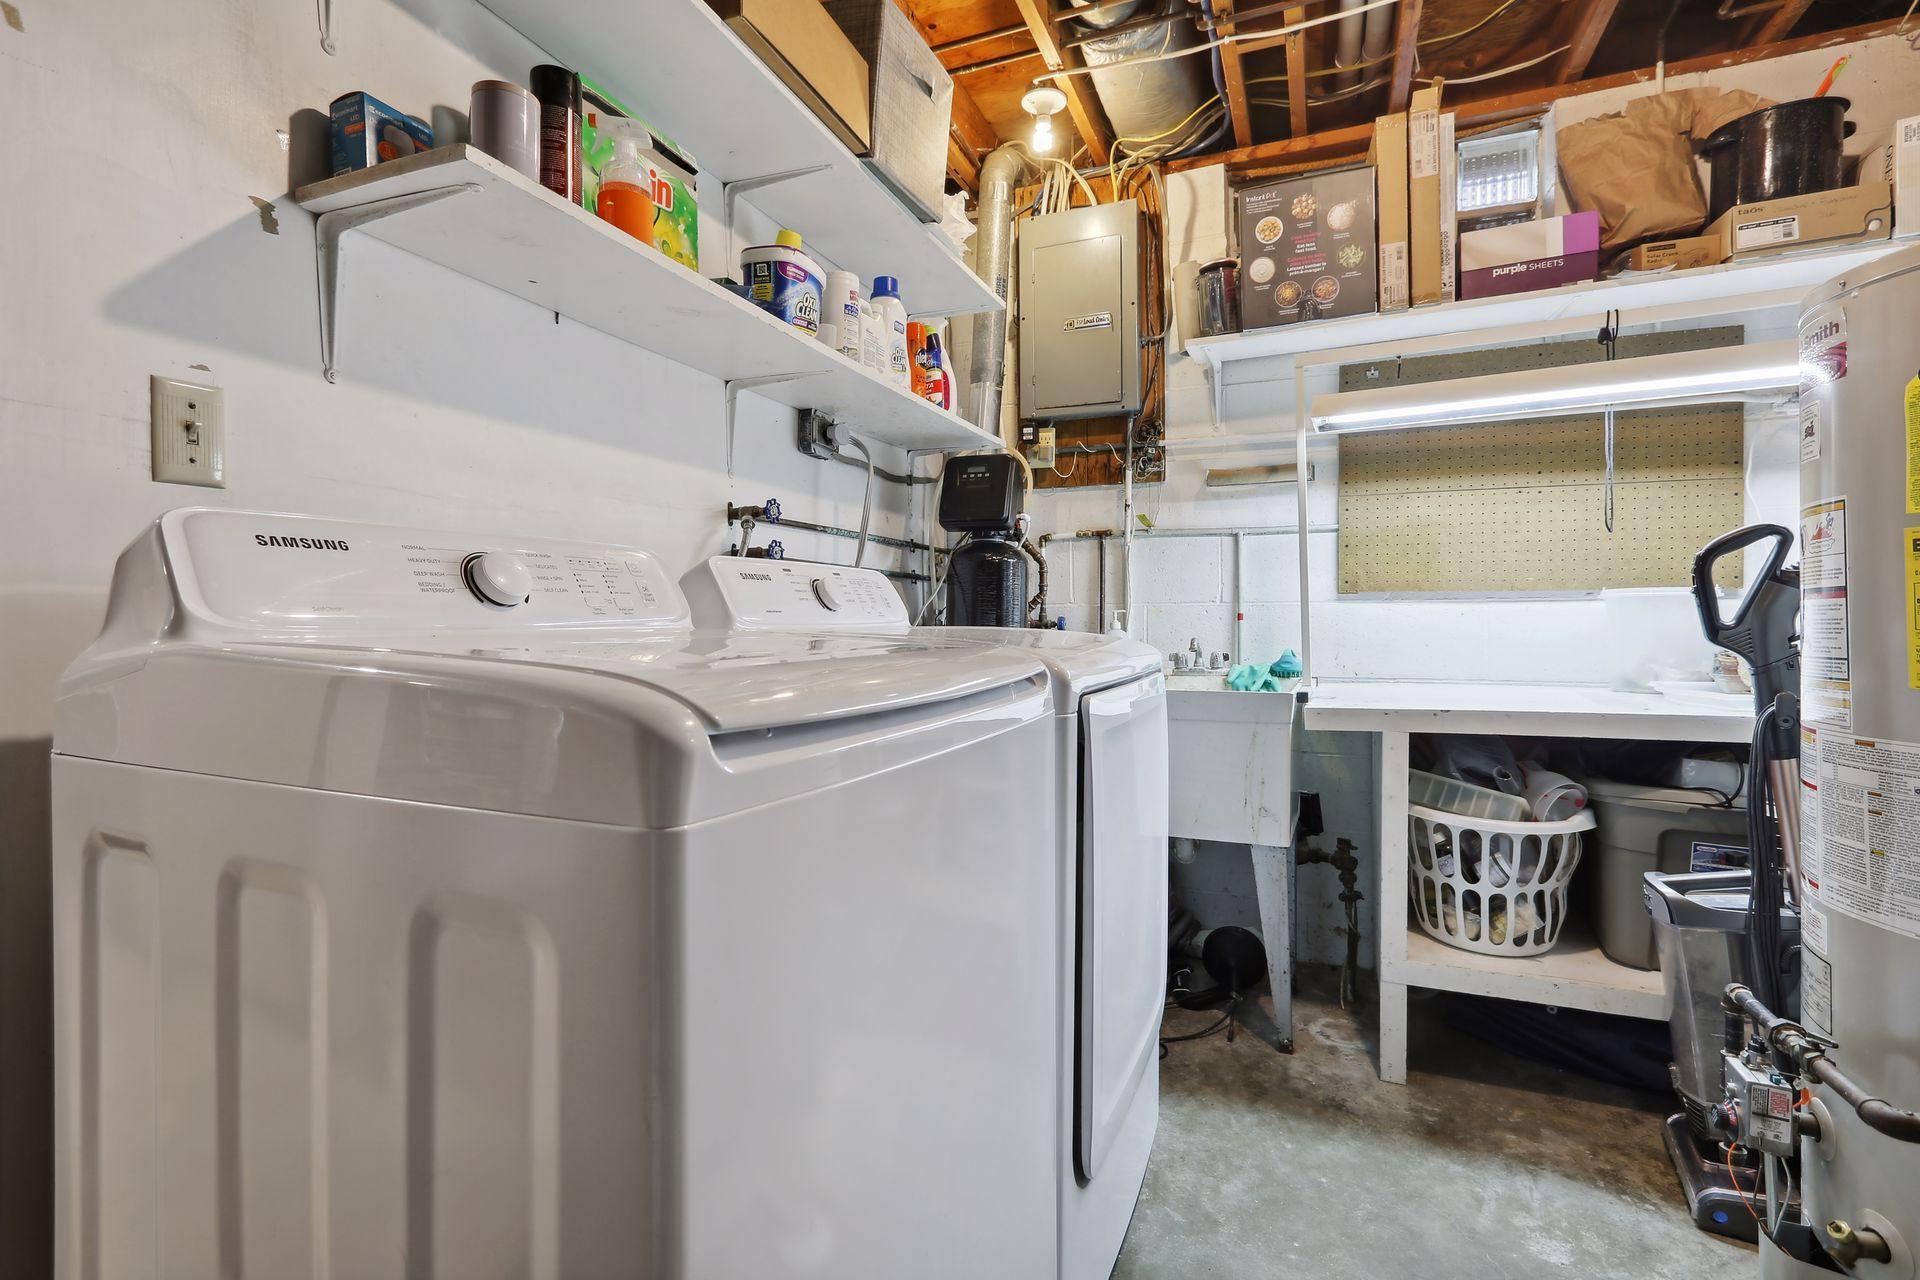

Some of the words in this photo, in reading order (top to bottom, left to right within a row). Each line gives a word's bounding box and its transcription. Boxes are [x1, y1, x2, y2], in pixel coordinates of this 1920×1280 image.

[649, 168, 674, 208] in
[1737, 206, 1765, 216] taos
[1492, 263, 1527, 278] purple
[1528, 258, 1564, 271] SHEETS
[795, 300, 818, 322] CLEAN
[254, 533, 350, 551] SAMSUNG
[739, 572, 772, 581] SAMSUNG
